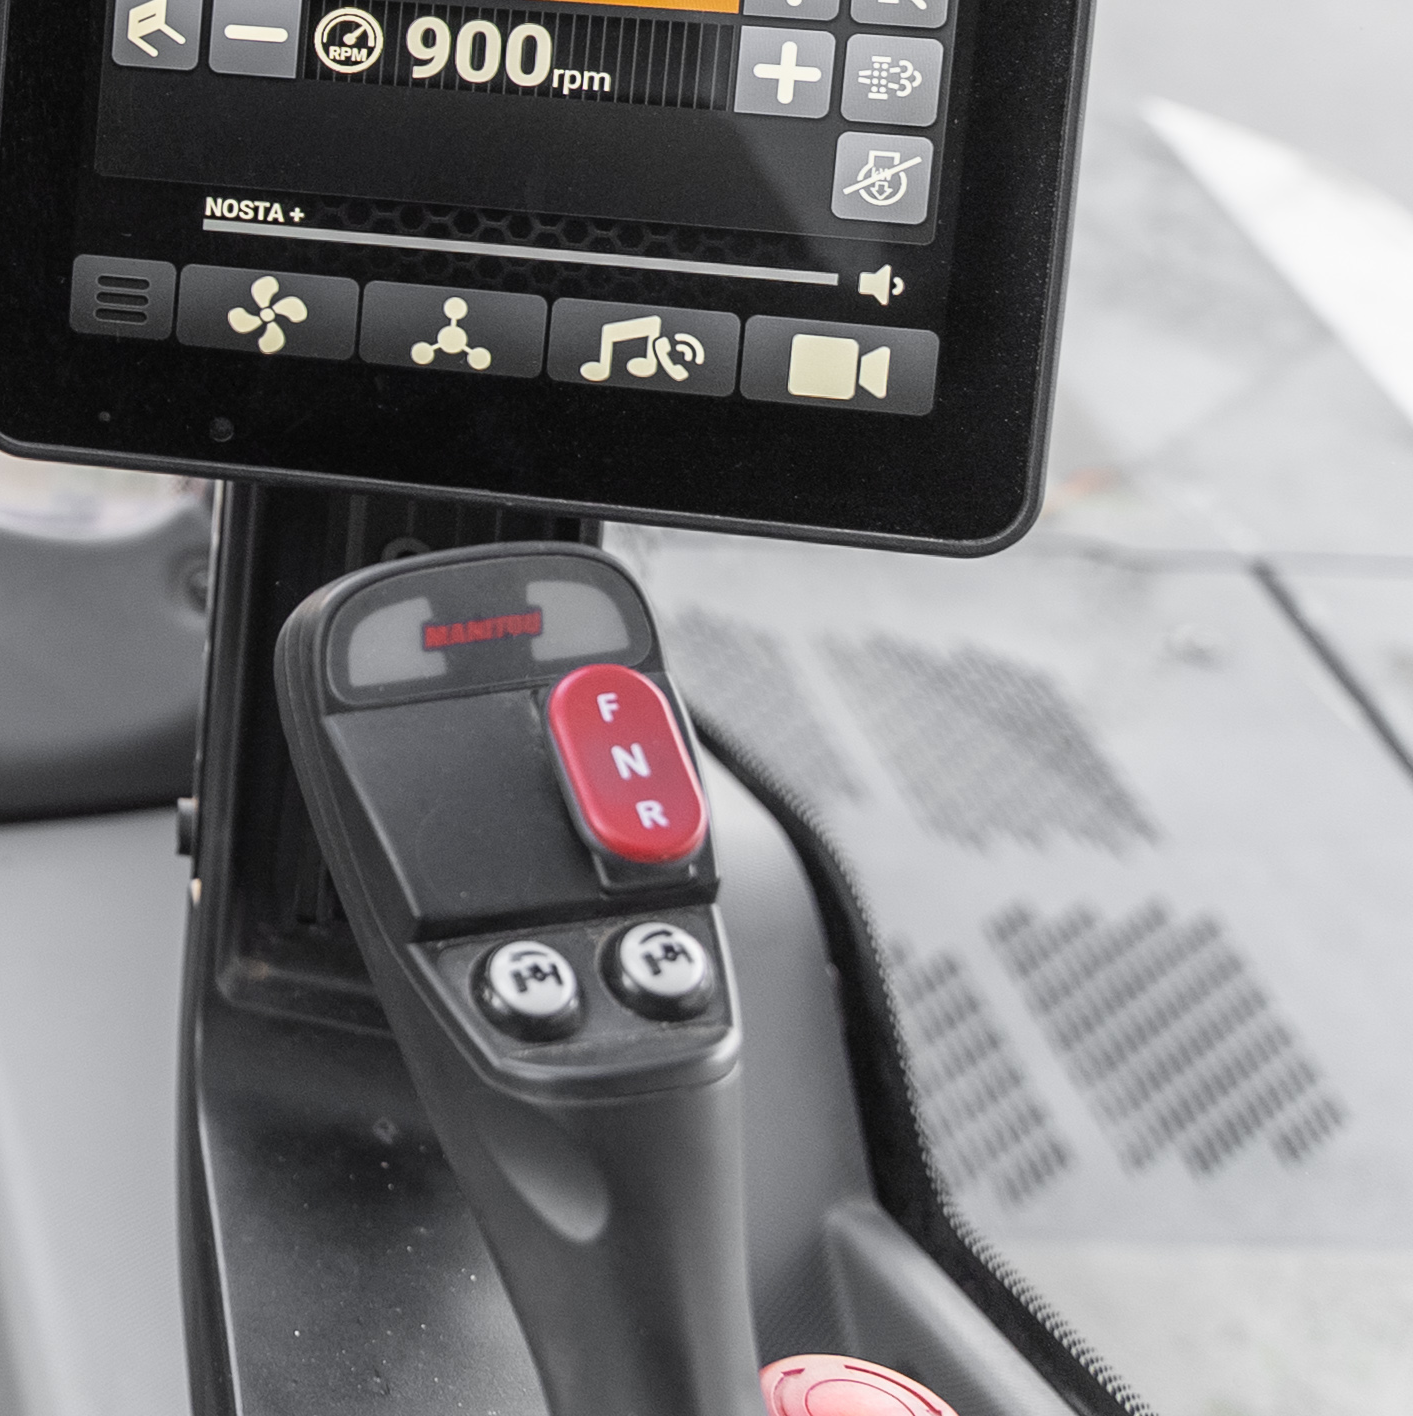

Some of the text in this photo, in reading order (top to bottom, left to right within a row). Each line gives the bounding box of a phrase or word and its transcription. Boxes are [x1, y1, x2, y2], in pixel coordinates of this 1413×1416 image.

[329, 46, 368, 64] RPM
[406, 15, 611, 94] 900 rpm
[205, 197, 284, 222] NOSTA
[425, 611, 542, 649] MANITOU
[597, 692, 620, 722] F
[611, 742, 652, 781] N
[635, 799, 670, 830] R
